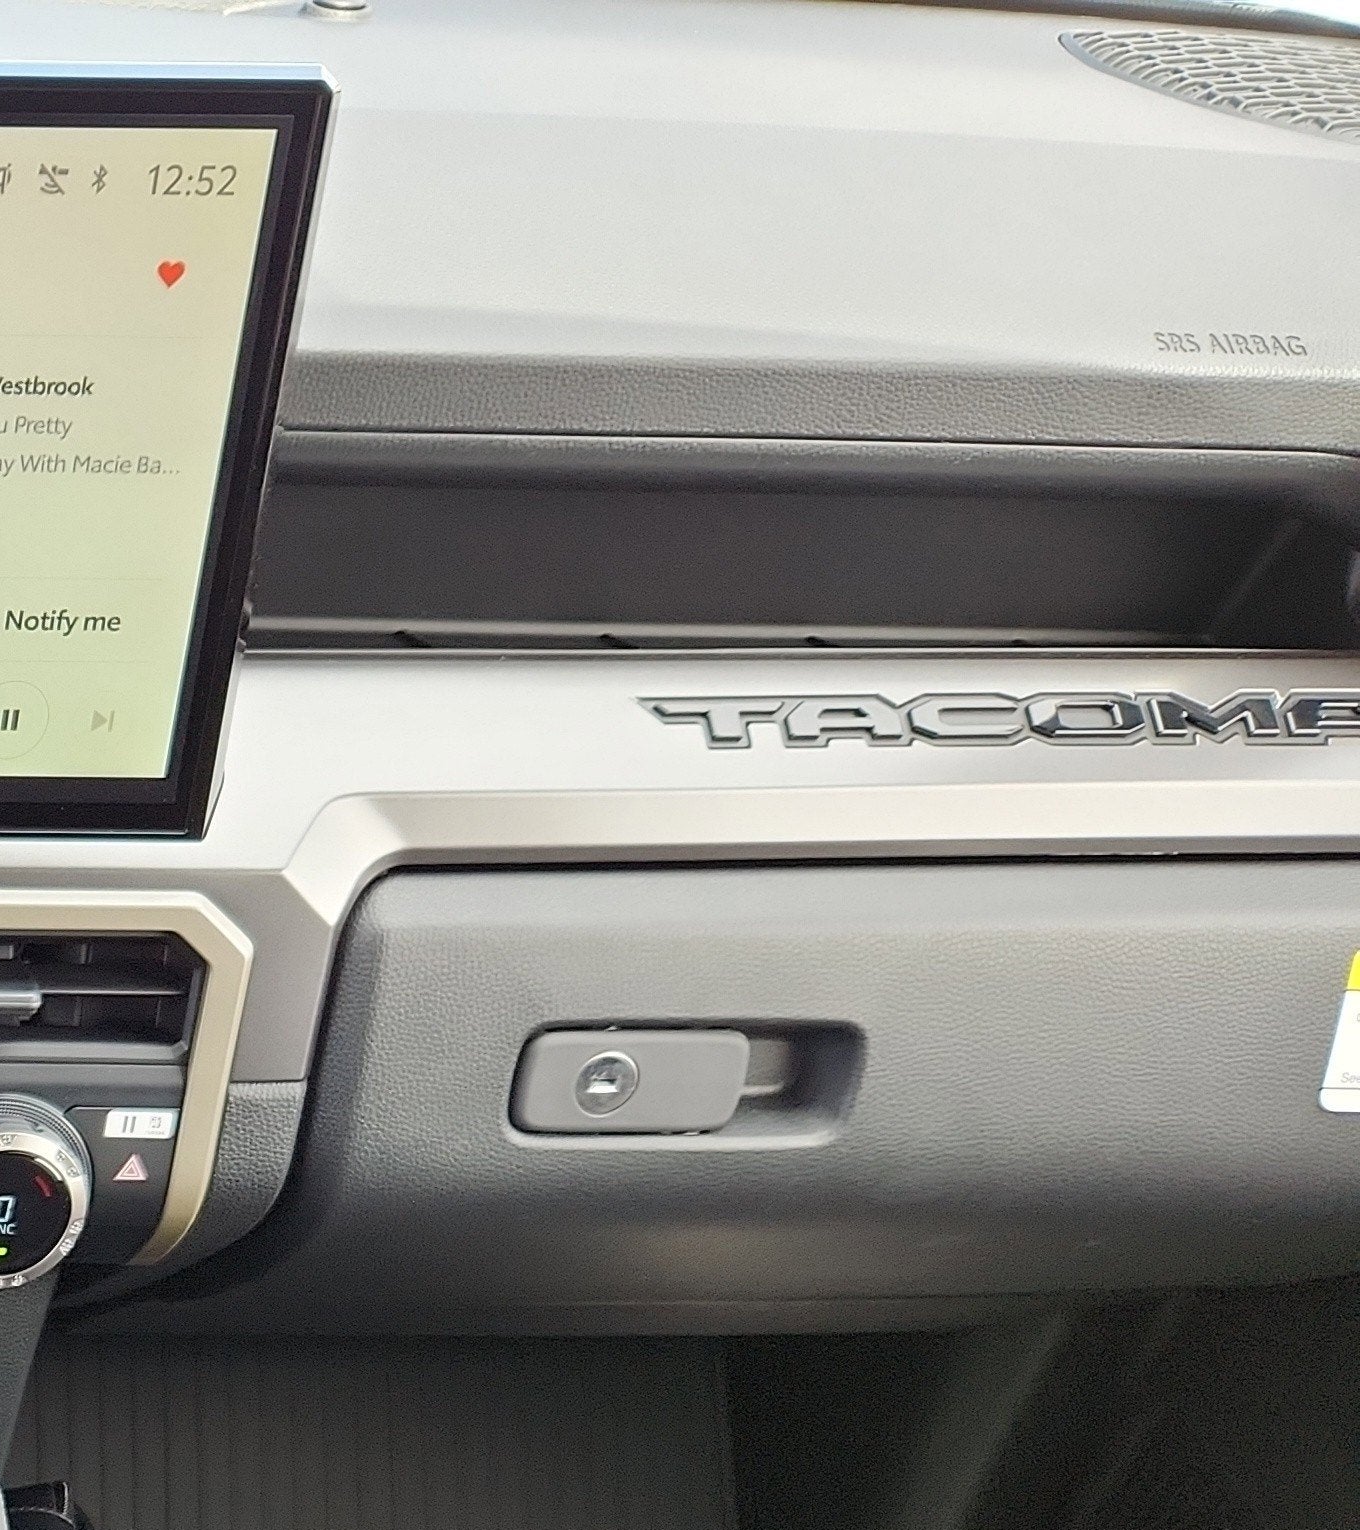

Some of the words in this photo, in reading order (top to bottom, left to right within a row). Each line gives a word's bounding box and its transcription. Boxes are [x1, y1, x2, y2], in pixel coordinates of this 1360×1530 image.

[148, 164, 238, 196] 12:52
[1154, 332, 1201, 353] SRS
[1209, 333, 1308, 356] AIRBAG
[15, 416, 73, 439] Pretty
[20, 454, 67, 473] With
[72, 455, 131, 474] Macie
[5, 611, 79, 635] Notify
[84, 616, 121, 632] me
